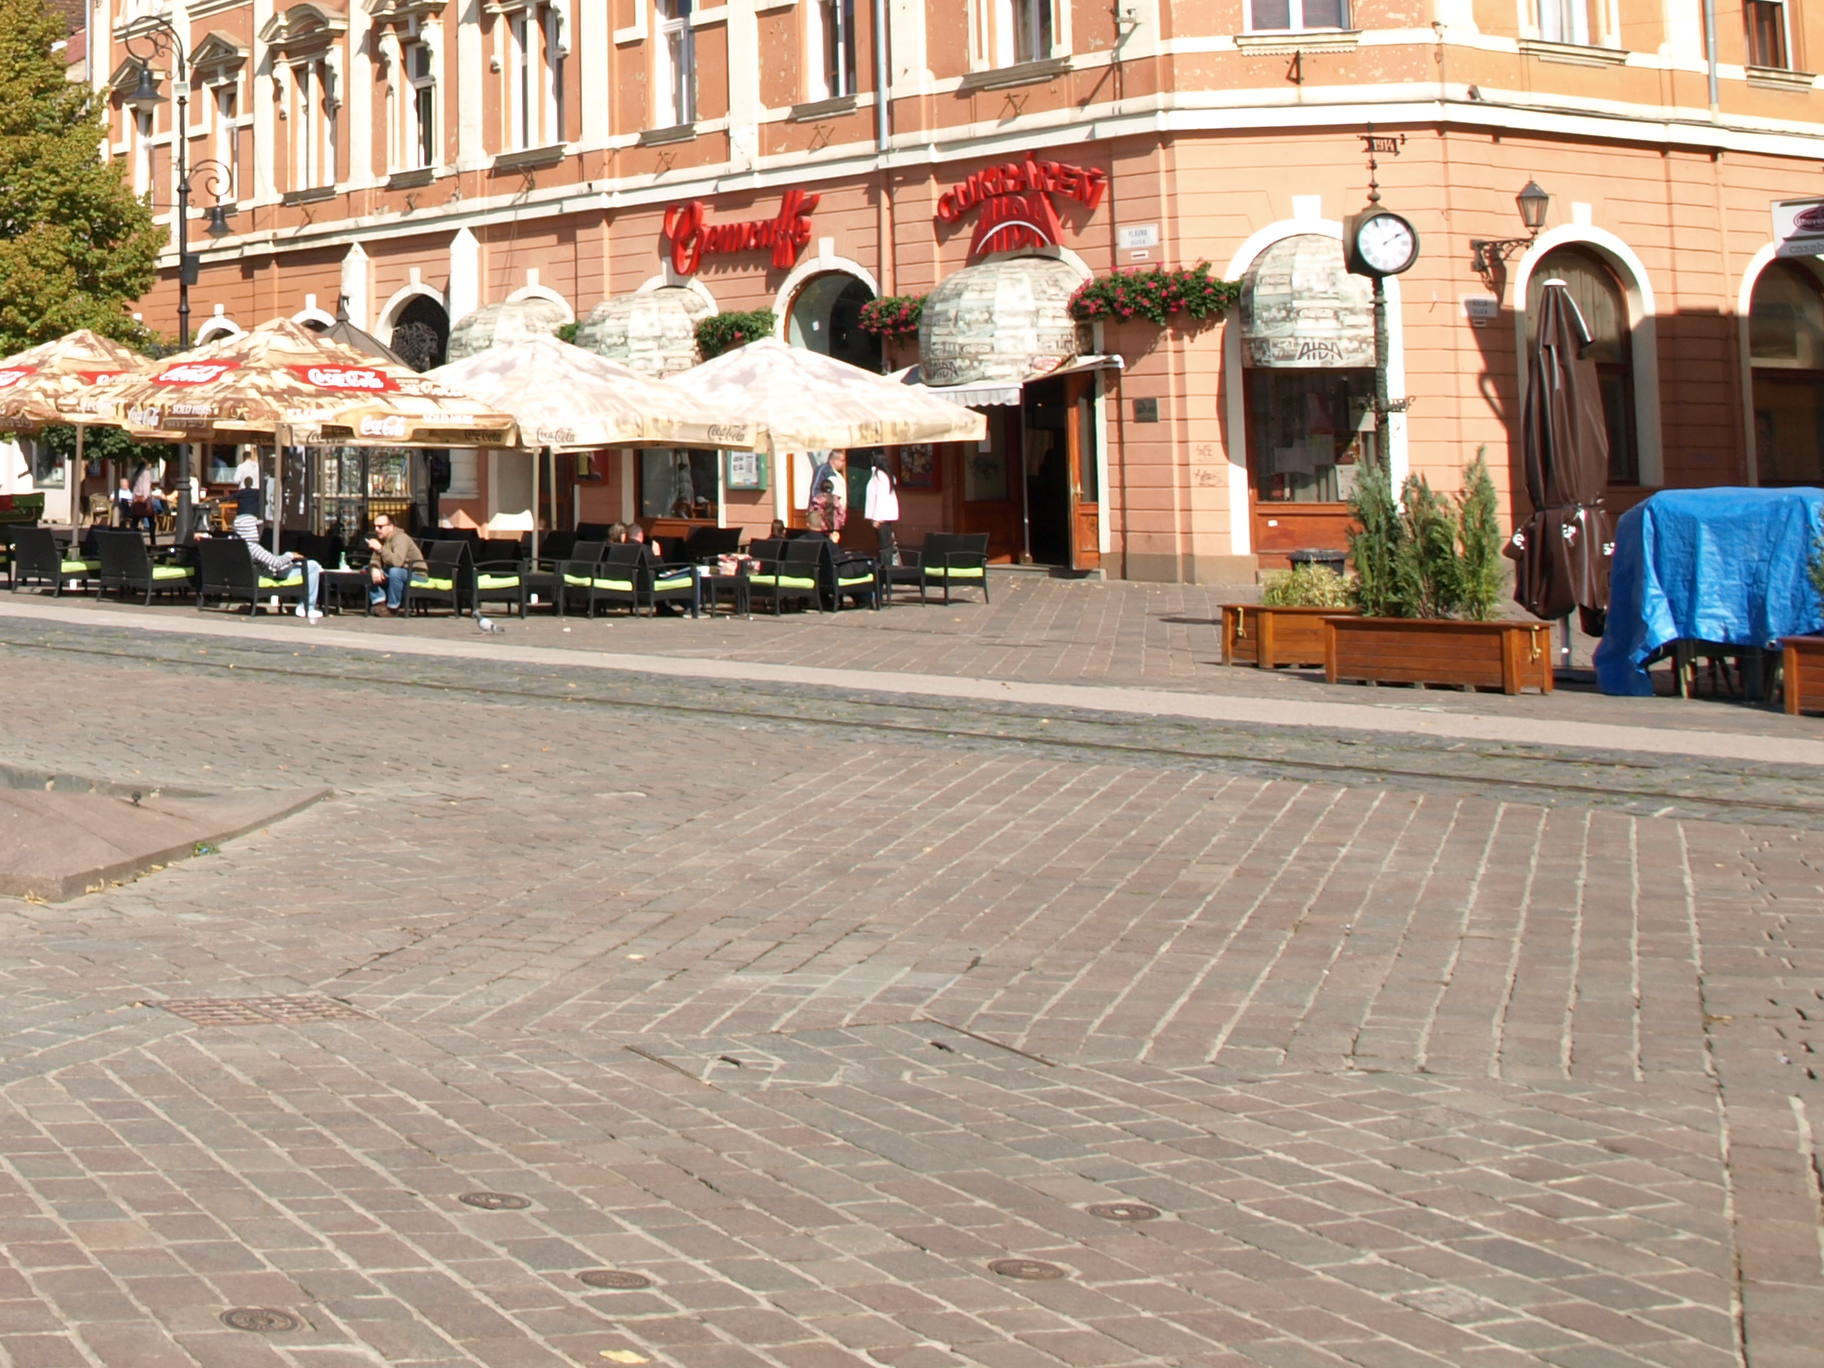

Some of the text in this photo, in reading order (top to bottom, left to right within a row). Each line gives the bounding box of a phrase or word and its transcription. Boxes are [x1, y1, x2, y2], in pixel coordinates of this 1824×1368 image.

[937, 150, 1107, 224] CUKRÁREŇ
[971, 191, 1066, 255] AIDA
[1297, 341, 1343, 360] AIDA
[308, 368, 384, 389] Coca-Cola
[360, 414, 407, 437] Coca-Cola
